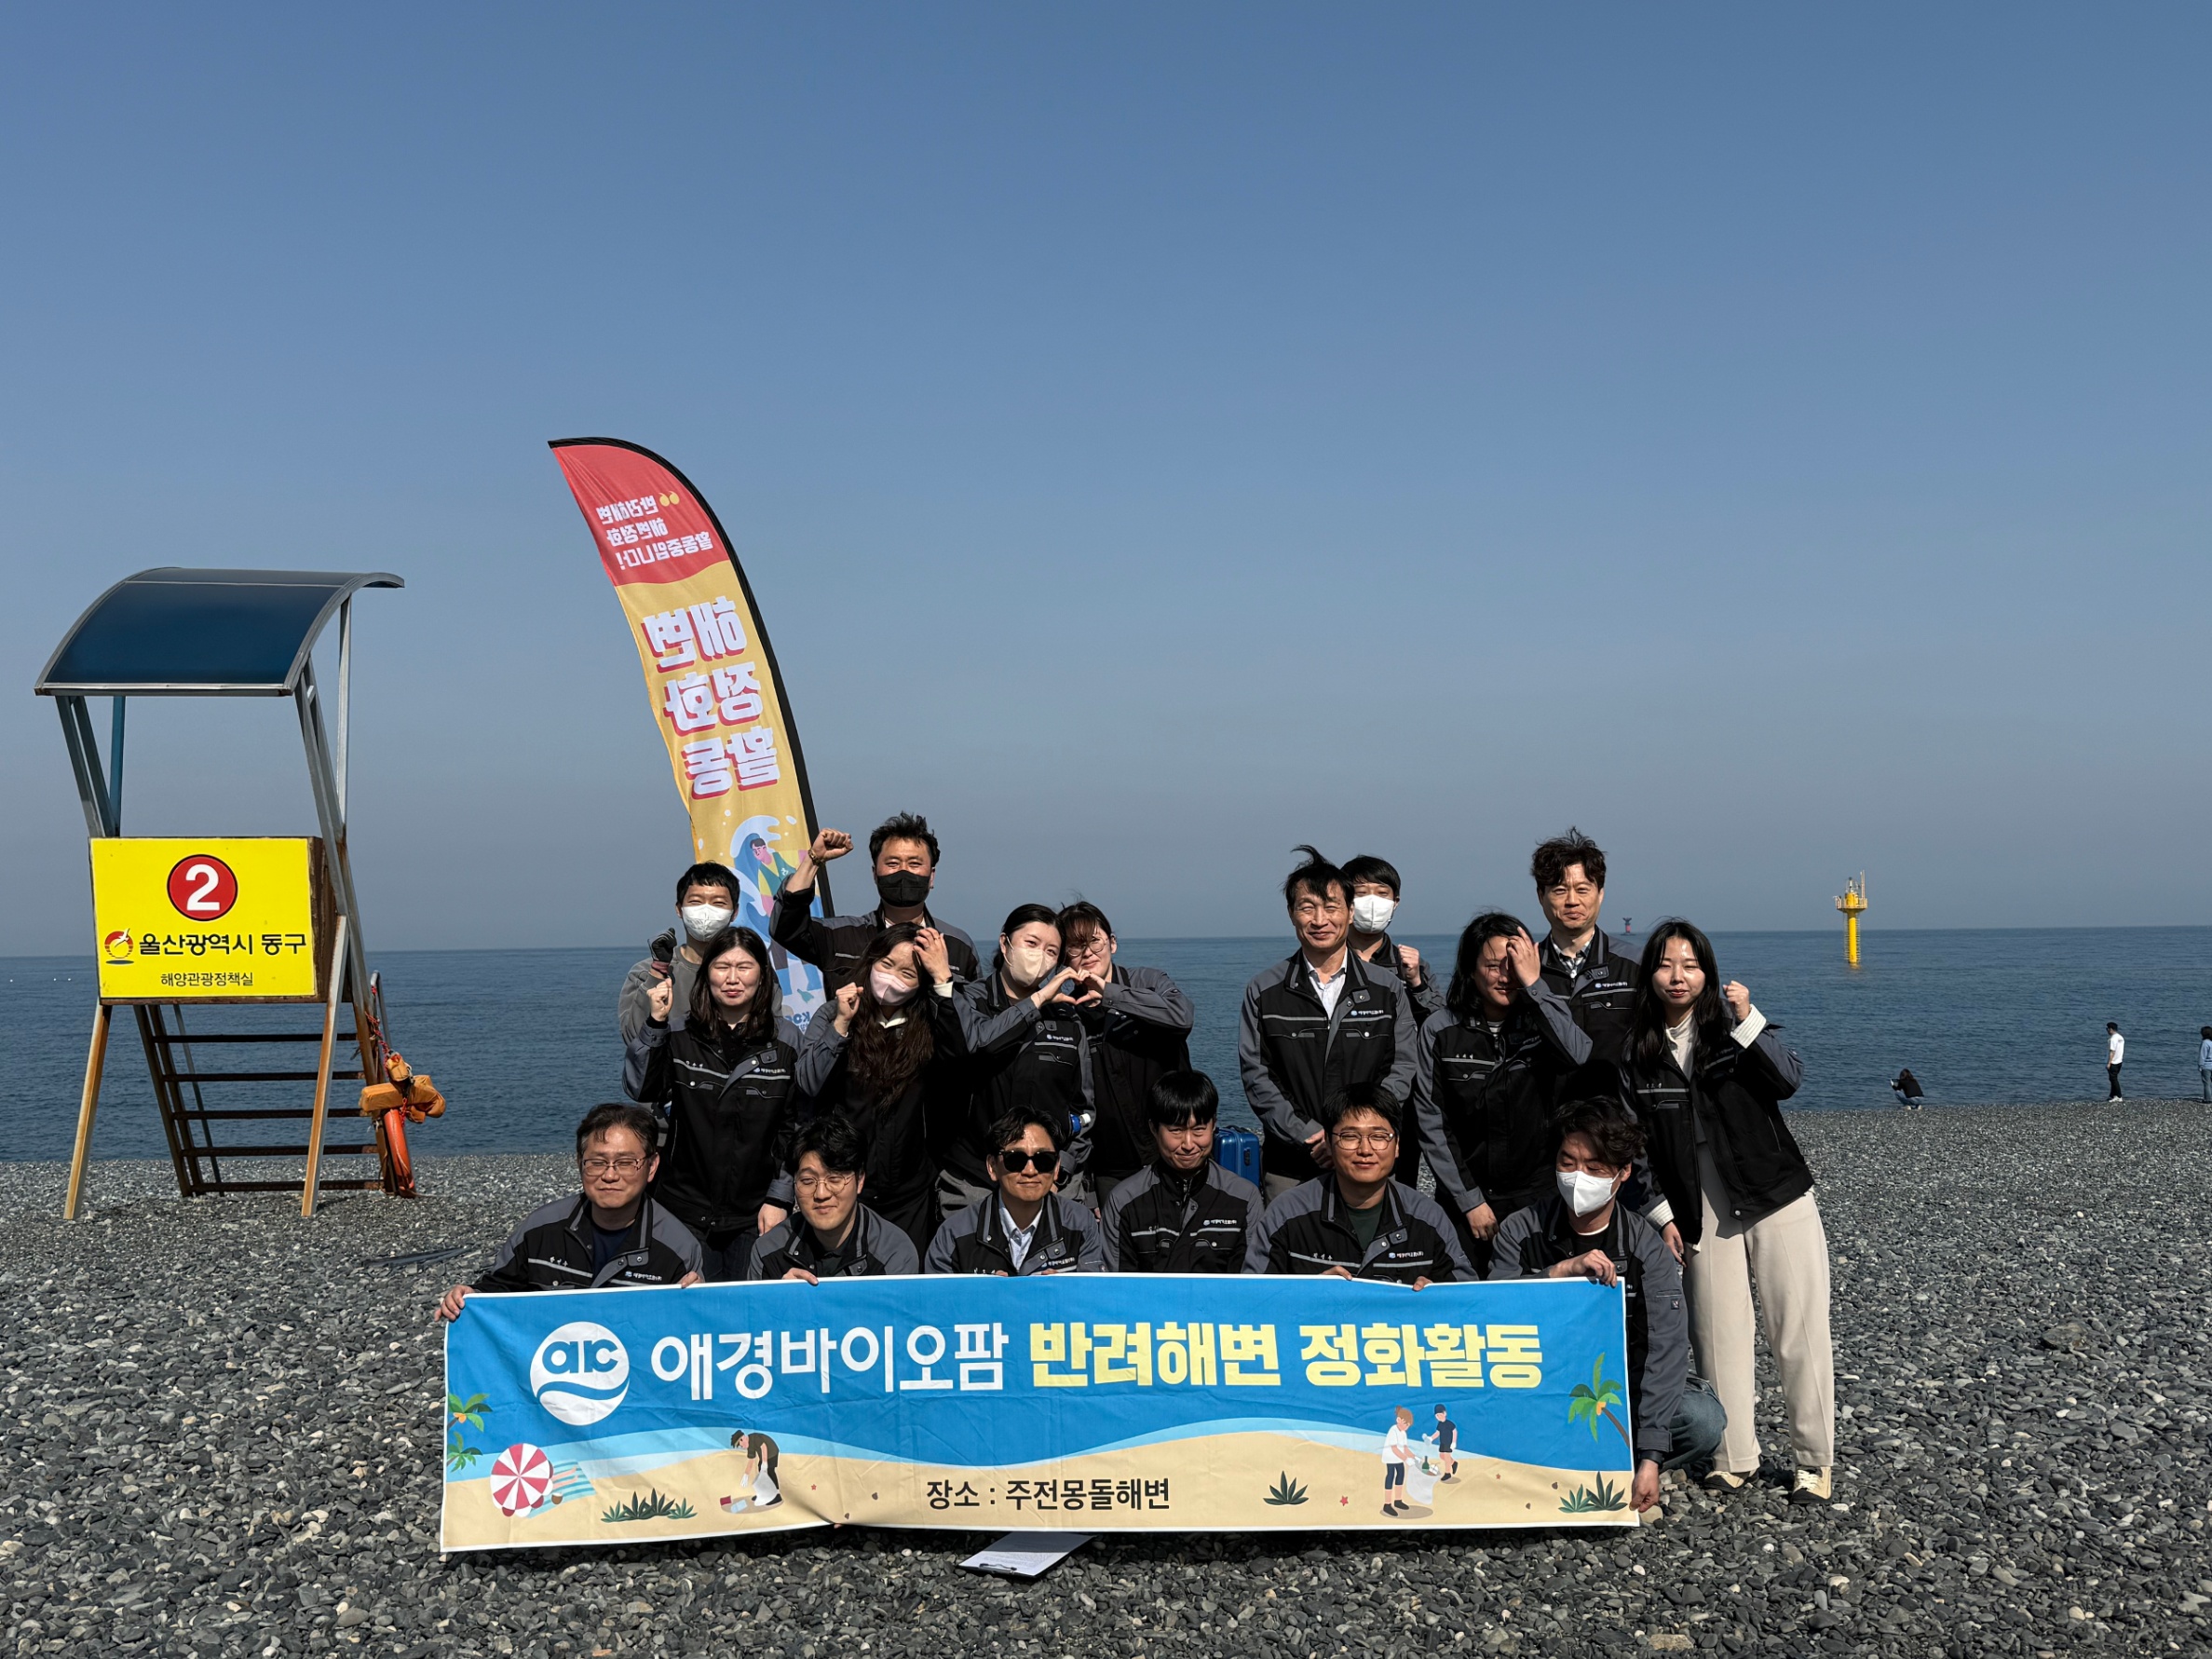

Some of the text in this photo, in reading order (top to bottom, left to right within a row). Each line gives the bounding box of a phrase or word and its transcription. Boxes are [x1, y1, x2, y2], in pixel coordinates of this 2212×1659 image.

[185, 863, 220, 911] 2
[139, 933, 307, 956] 울산광역시 동구
[160, 972, 254, 986] 해양관광정책실
[651, 1321, 1543, 1401] 애경바이오팜 반려해변 정화활동
[927, 1479, 980, 1510] 장소
[1006, 1478, 1170, 1510] 주전몽돌해변
